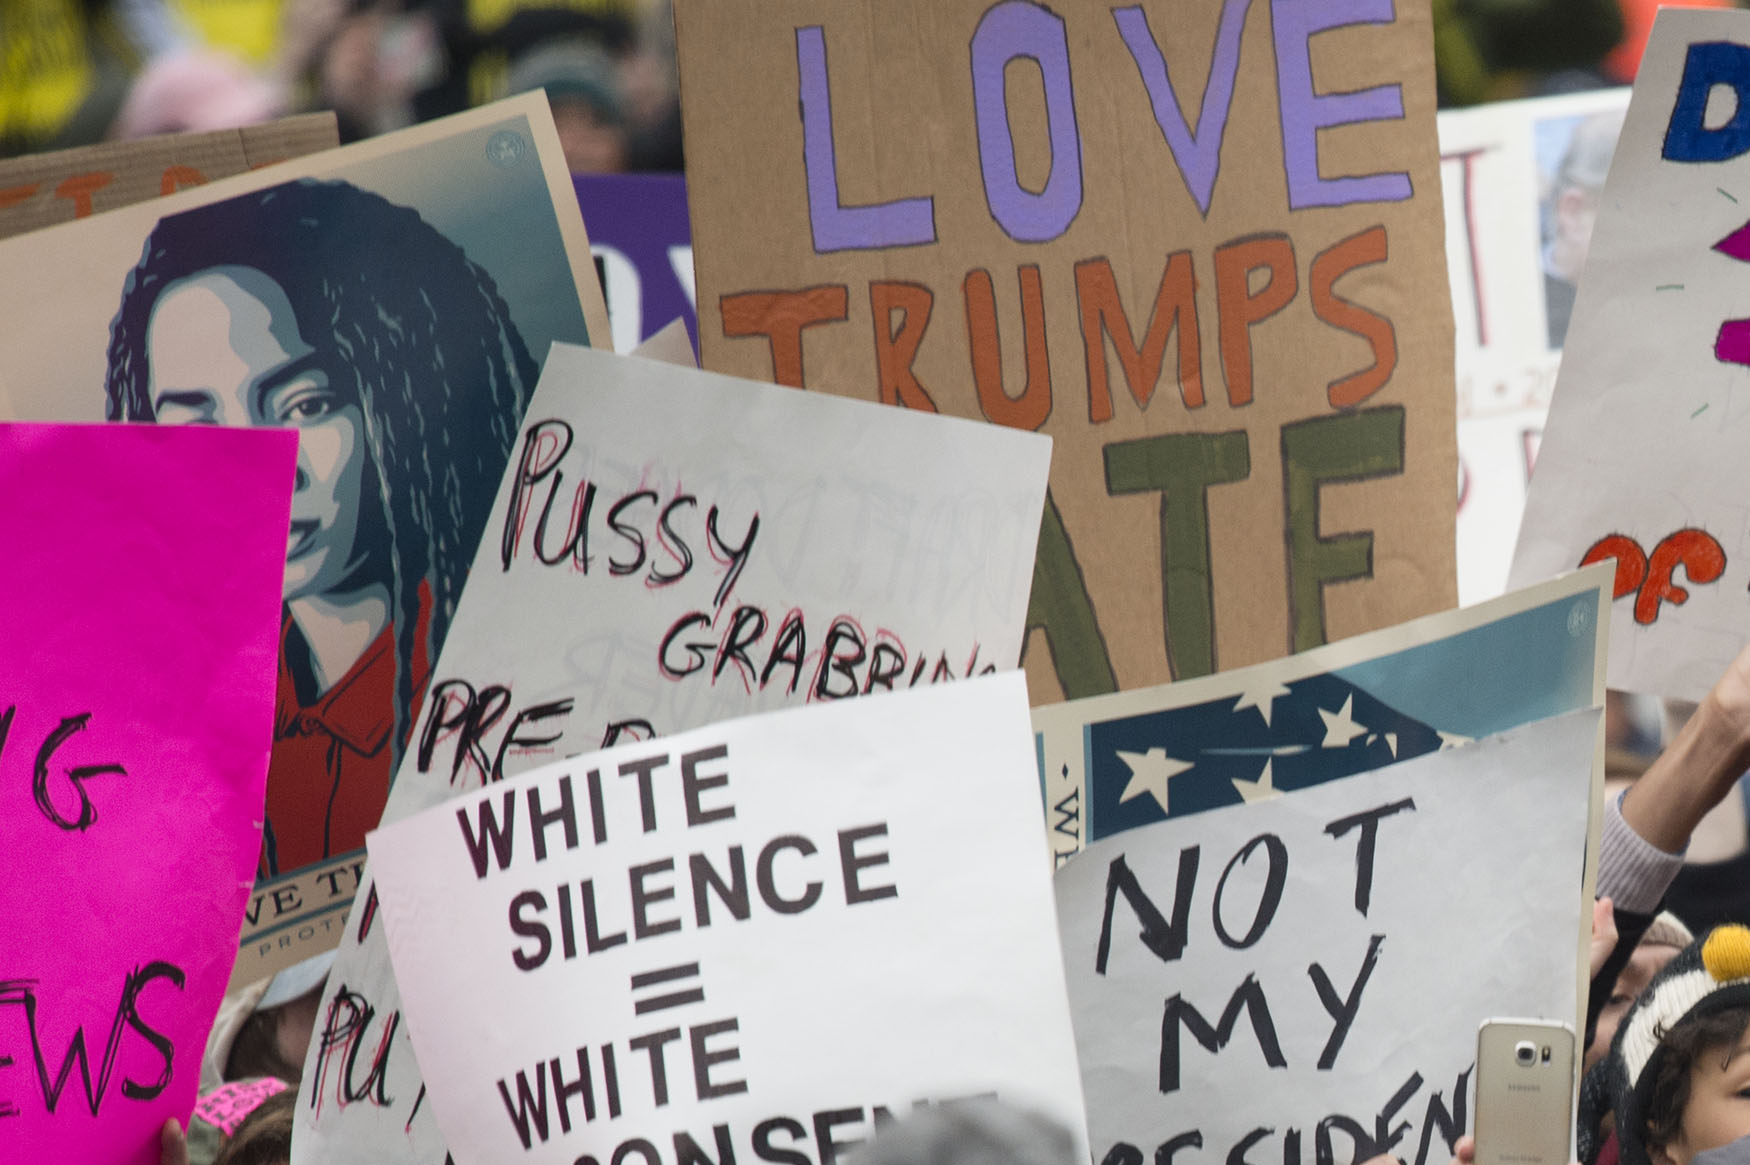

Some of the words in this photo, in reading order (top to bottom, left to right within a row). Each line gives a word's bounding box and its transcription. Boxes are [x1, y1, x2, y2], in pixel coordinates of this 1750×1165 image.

[795, 0, 1414, 254] LOVE
[719, 224, 1398, 433] TRUMPS
[0, 703, 129, 833] G
[418, 678, 655, 786] PRE
[456, 743, 736, 880] WHITE
[508, 822, 899, 972] SILENCE
[1095, 796, 1418, 976] NOT
[630, 961, 706, 1018] =
[1159, 934, 1387, 1095] MY
[497, 1017, 749, 1152] WHITE
